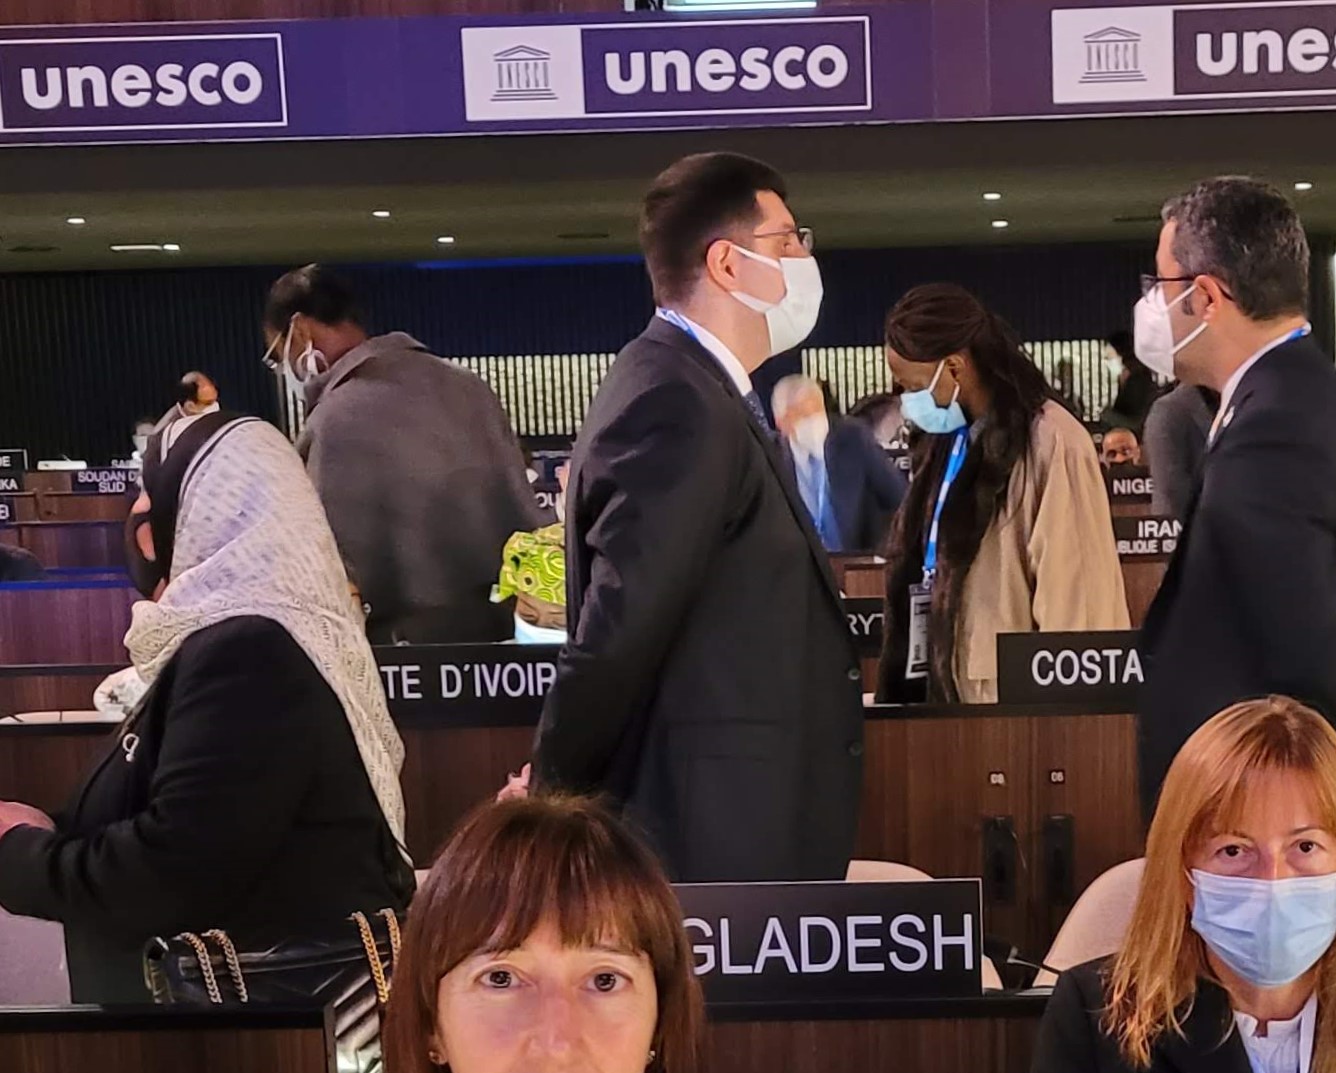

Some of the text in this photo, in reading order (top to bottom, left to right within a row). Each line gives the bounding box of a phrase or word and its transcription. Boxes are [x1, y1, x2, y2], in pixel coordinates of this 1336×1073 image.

[21, 61, 262, 109] unesco
[604, 44, 849, 94] unesco
[78, 471, 126, 483] SOUDAN
[98, 481, 126, 493] SUD
[1031, 648, 1145, 686] COSTA
